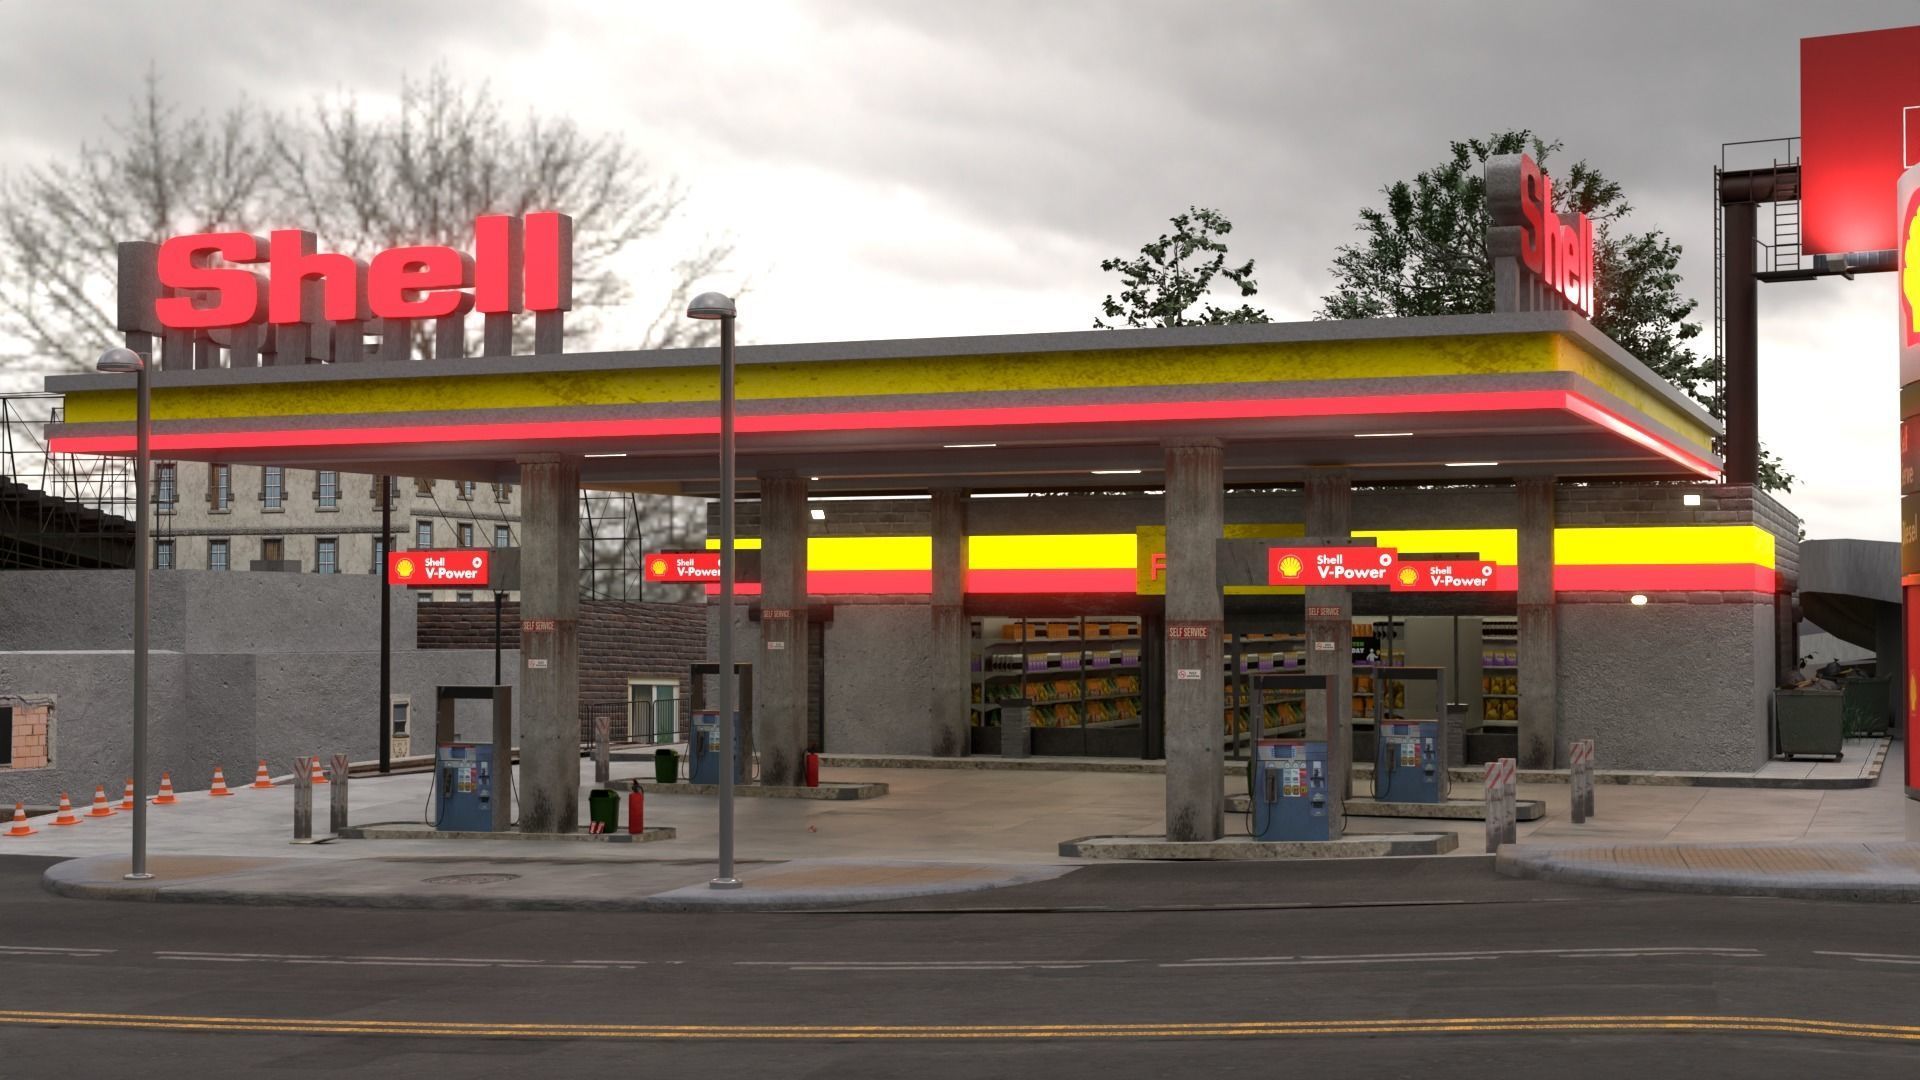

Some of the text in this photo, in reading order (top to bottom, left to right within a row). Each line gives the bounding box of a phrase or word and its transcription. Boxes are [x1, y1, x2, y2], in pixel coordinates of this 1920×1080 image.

[1521, 153, 1594, 320] Shell
[155, 211, 559, 328] Shell
[425, 556, 446, 567] Shell
[677, 558, 695, 568] Shell
[1317, 554, 1343, 565] Shell
[425, 566, 478, 579] V-Power
[1317, 566, 1387, 580] V-Power
[1430, 566, 1452, 575] Shell
[1430, 575, 1489, 587] V-Power
[1308, 607, 1340, 616] SELF SERVICE
[523, 621, 553, 630] SELF SERVICE
[1169, 627, 1208, 637] SELF SERVICE
